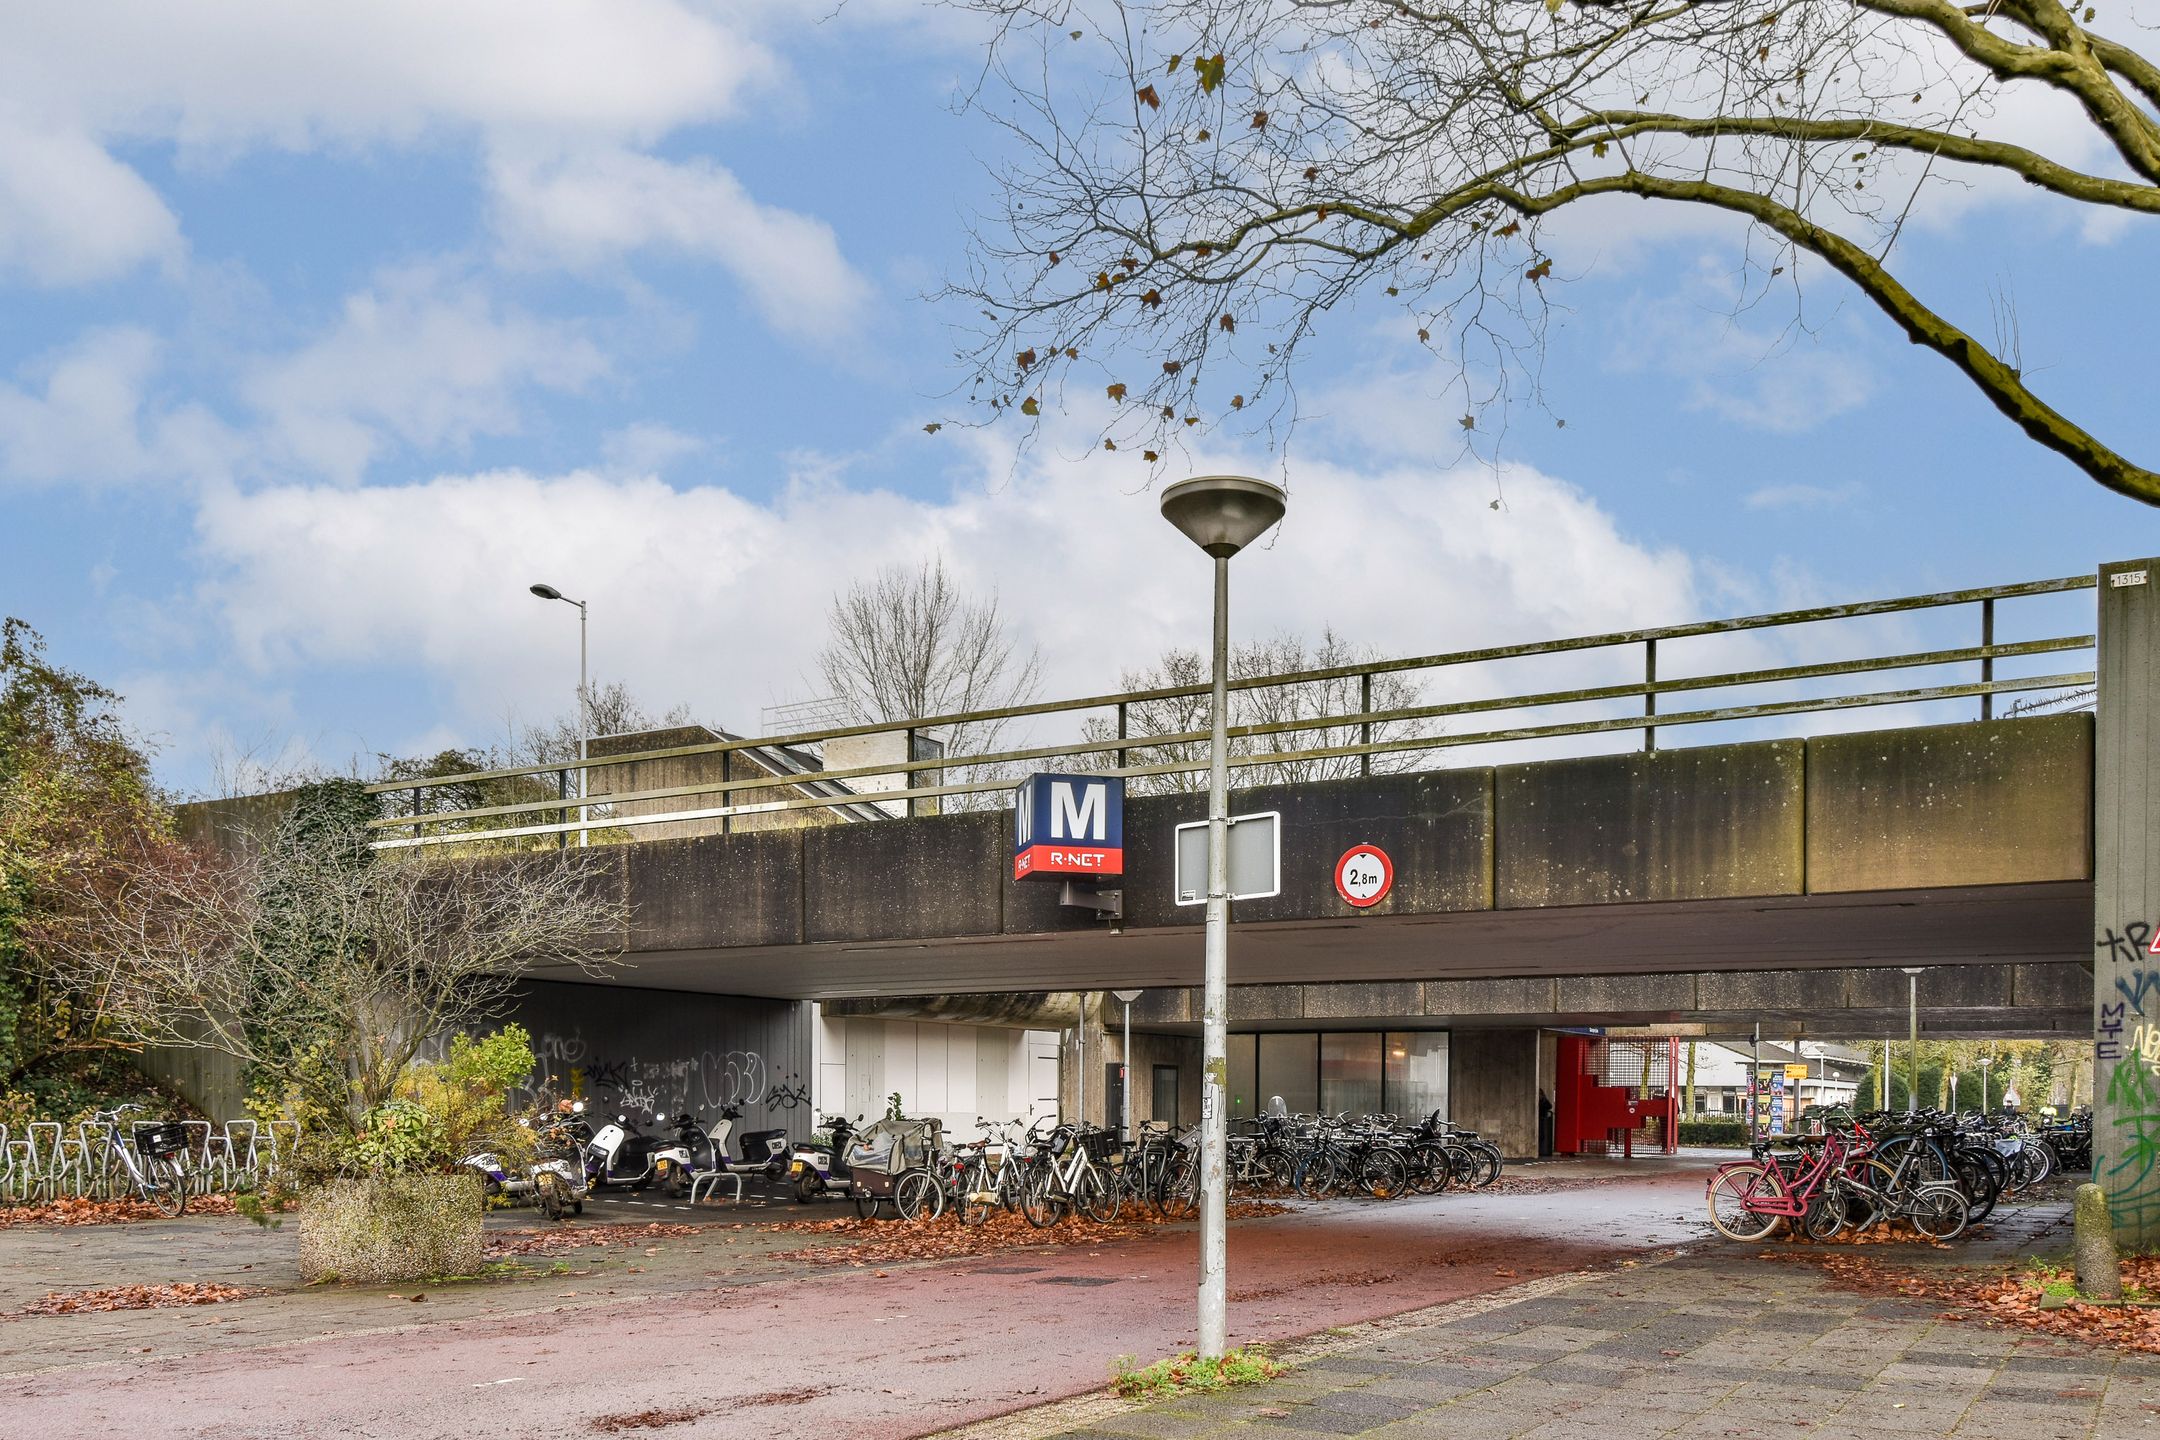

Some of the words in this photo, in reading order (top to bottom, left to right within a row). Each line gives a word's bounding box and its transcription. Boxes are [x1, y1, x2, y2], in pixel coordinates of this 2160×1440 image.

[2117, 573, 2141, 586] 1315
[1018, 784, 1032, 846] M
[1050, 781, 1106, 841] M
